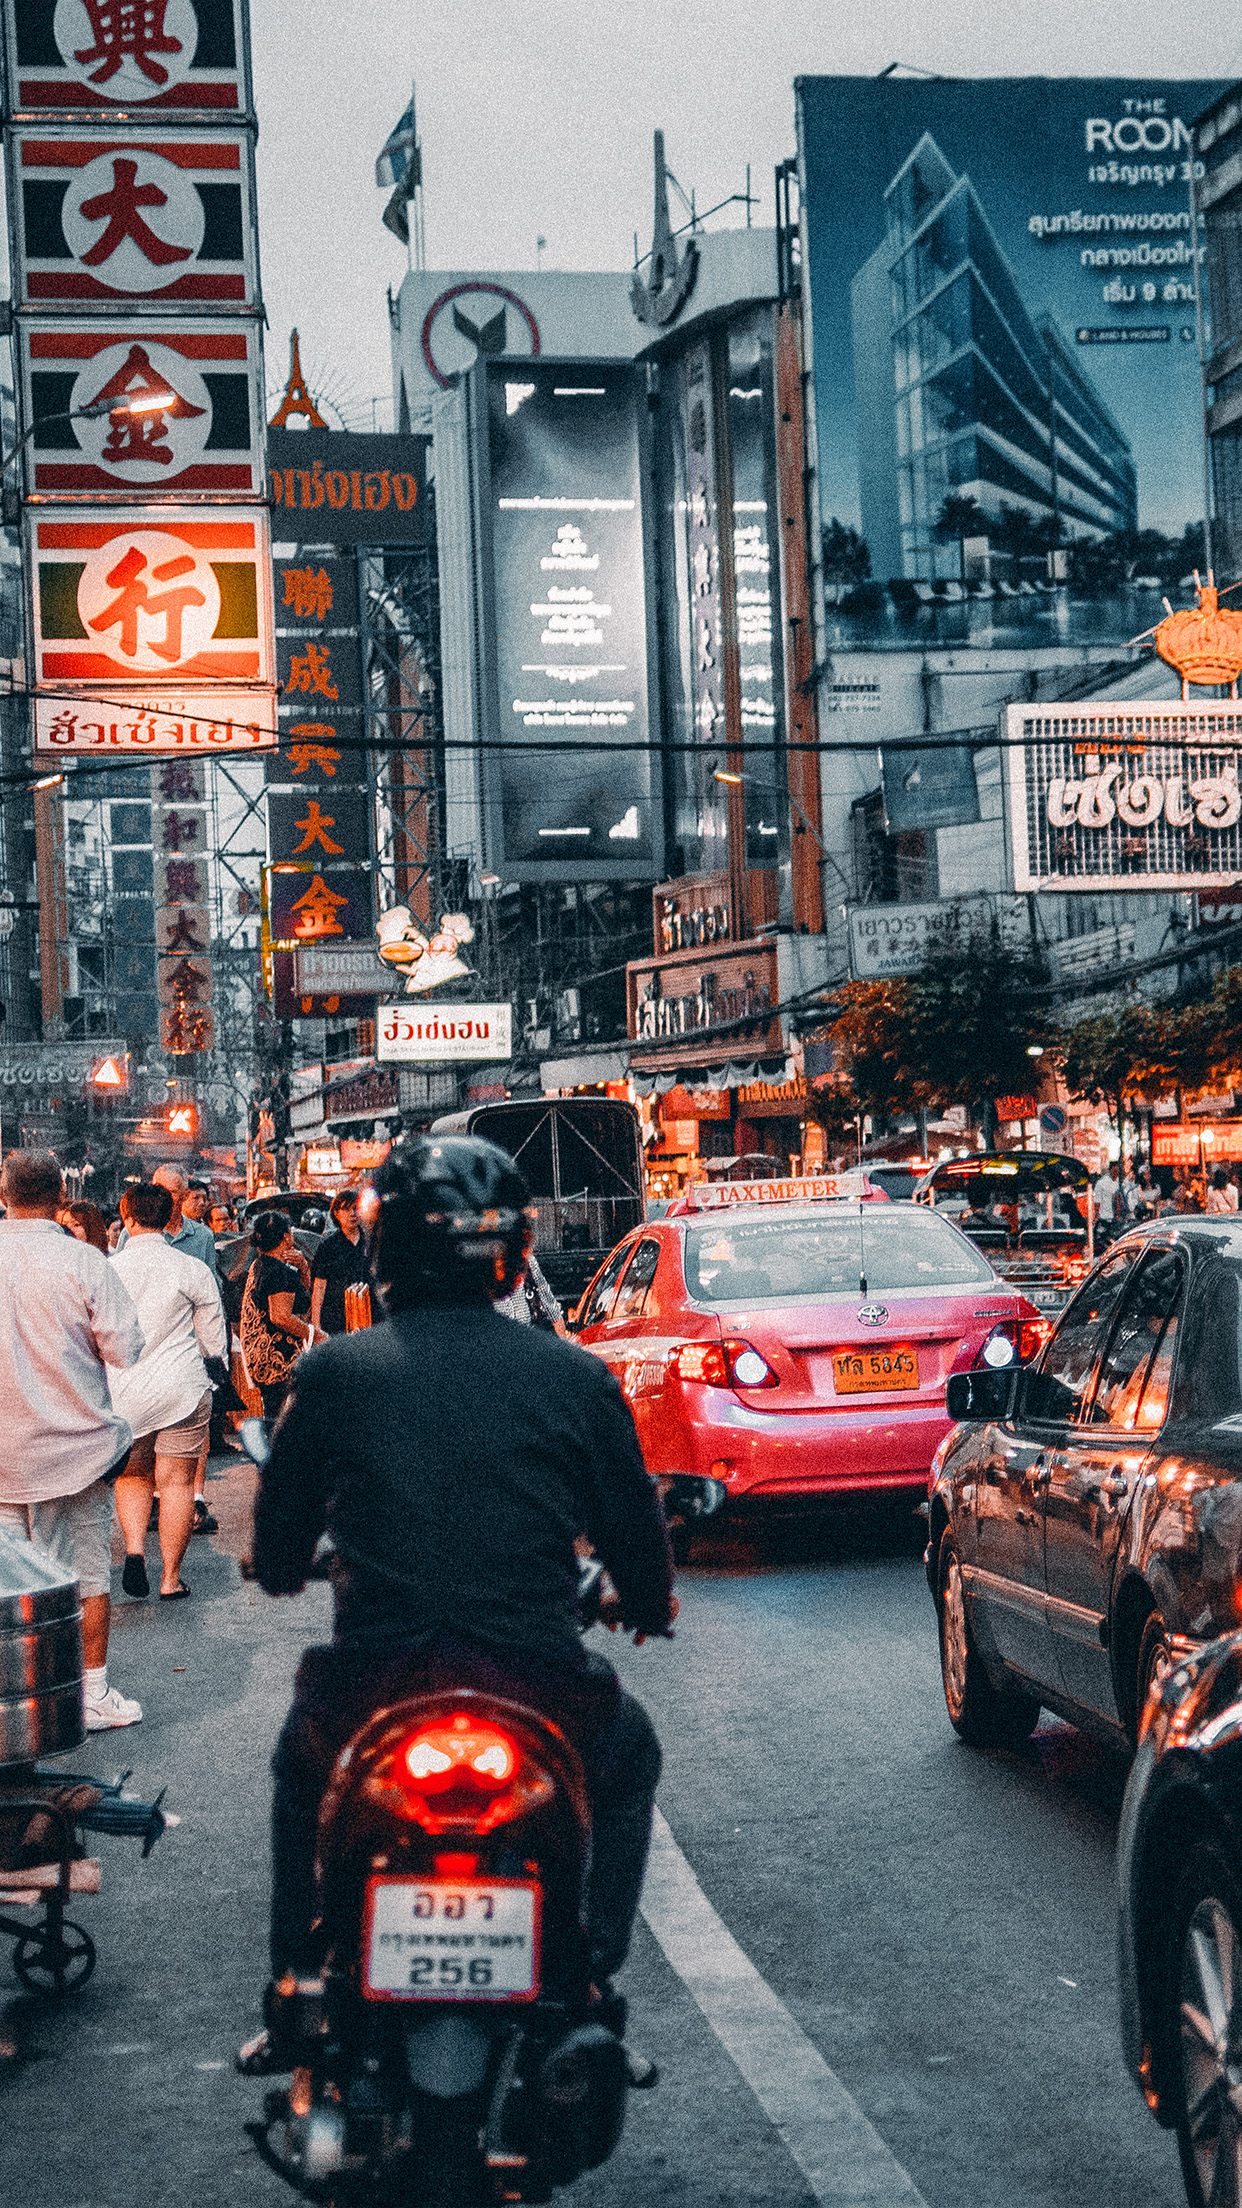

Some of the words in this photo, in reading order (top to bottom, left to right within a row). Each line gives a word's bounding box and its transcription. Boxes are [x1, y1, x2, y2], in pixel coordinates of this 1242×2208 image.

[1122, 98, 1167, 114] THE
[715, 1179, 839, 1202] TAXI-METER
[870, 1352, 915, 1374] 5845
[408, 1956, 494, 1986] 256
